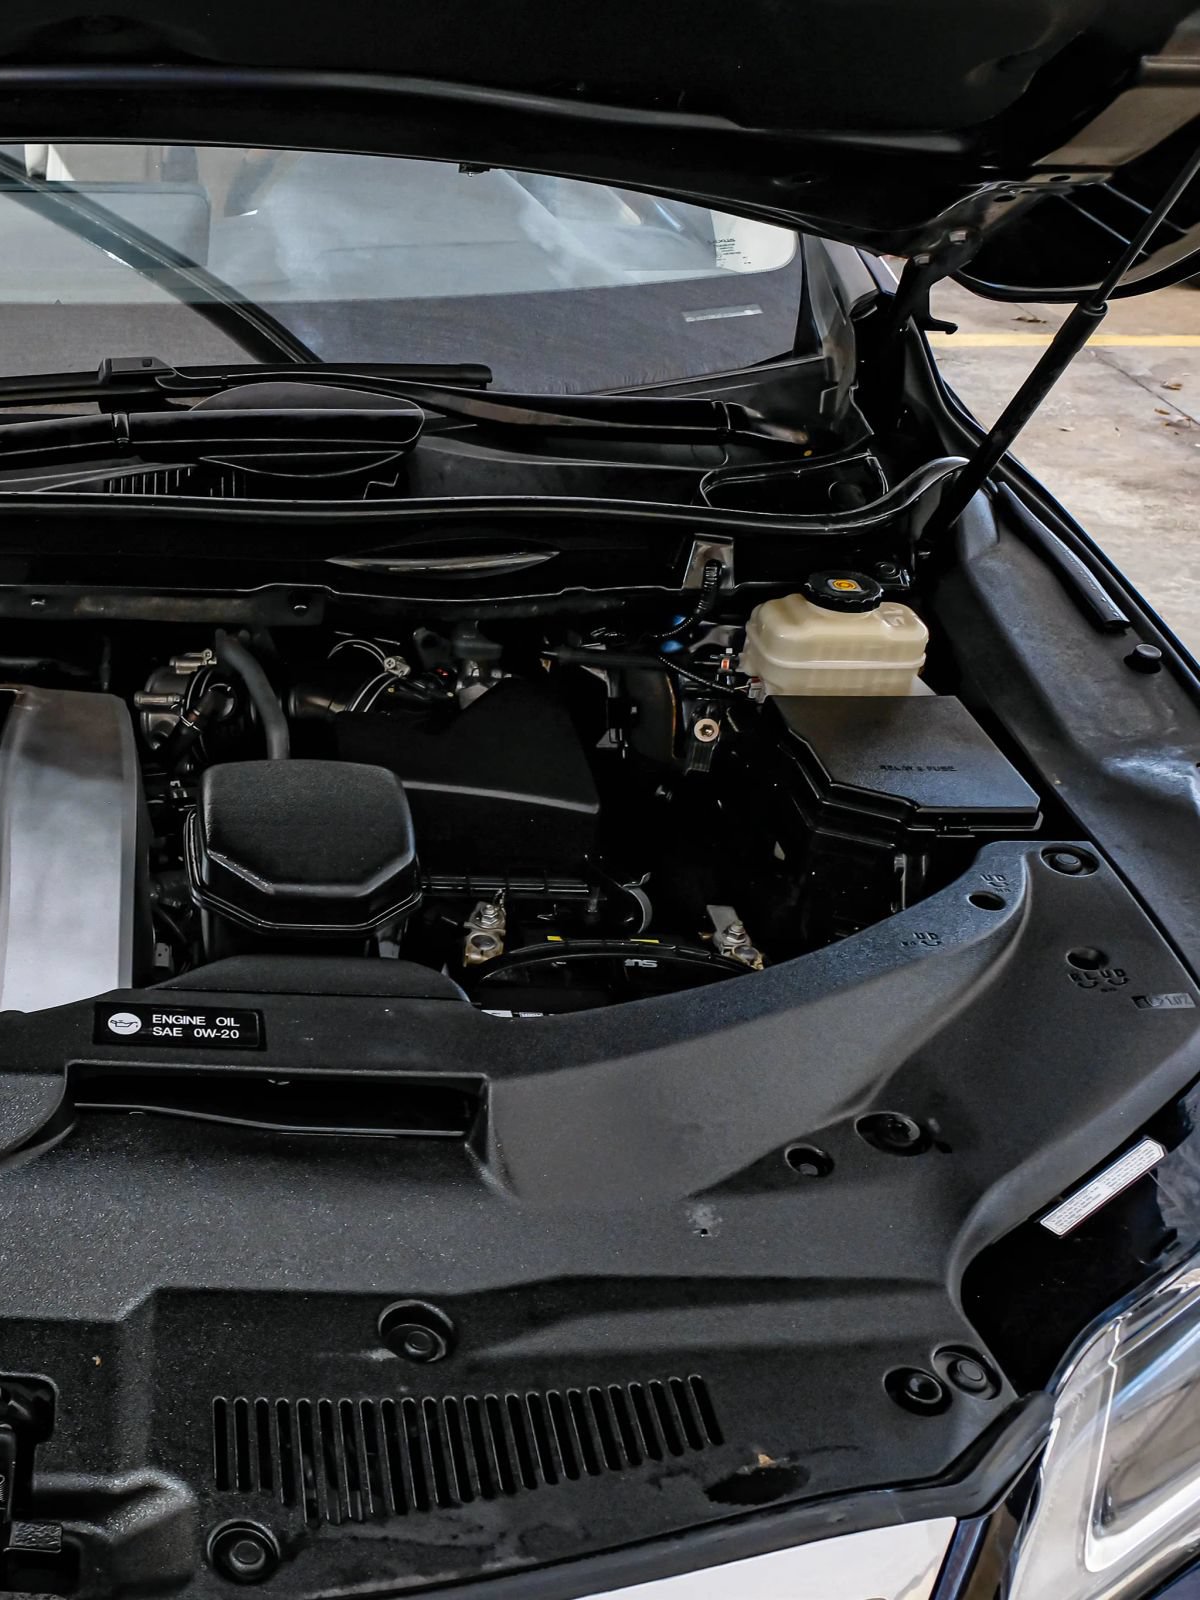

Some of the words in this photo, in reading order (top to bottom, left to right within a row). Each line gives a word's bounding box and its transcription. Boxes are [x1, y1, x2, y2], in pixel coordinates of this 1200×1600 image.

[152, 1014, 206, 1026] ENGINE
[215, 1017, 240, 1027] OIL
[152, 1027, 183, 1037] SAE
[193, 1029, 240, 1039] 0W-20
